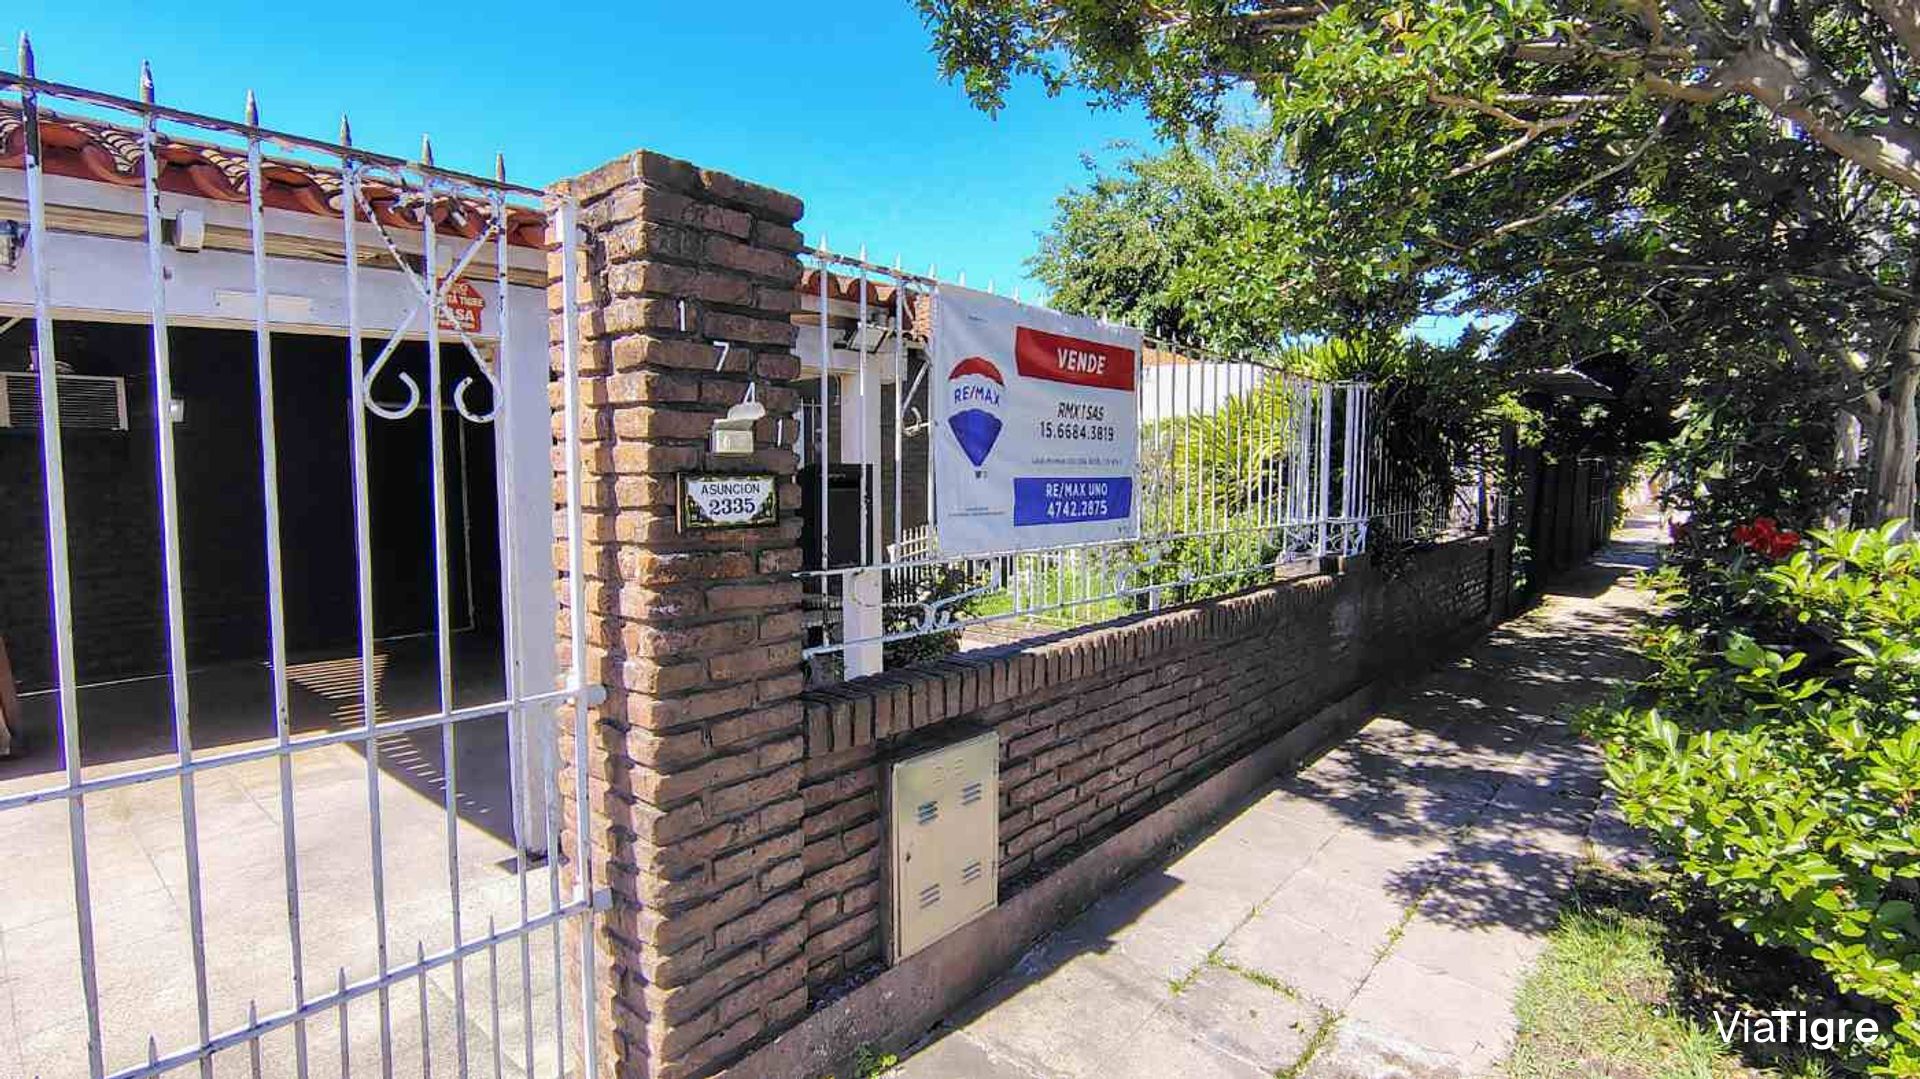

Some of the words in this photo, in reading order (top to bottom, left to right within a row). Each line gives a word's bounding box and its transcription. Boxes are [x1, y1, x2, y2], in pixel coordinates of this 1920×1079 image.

[1057, 348, 1107, 375] VENDE
[954, 385, 1000, 407] RE/MAX
[1046, 483, 1085, 497] RE/MAX
[1088, 483, 1108, 497] UNO
[709, 498, 756, 515] 2335
[1047, 500, 1108, 518] 4742.2875
